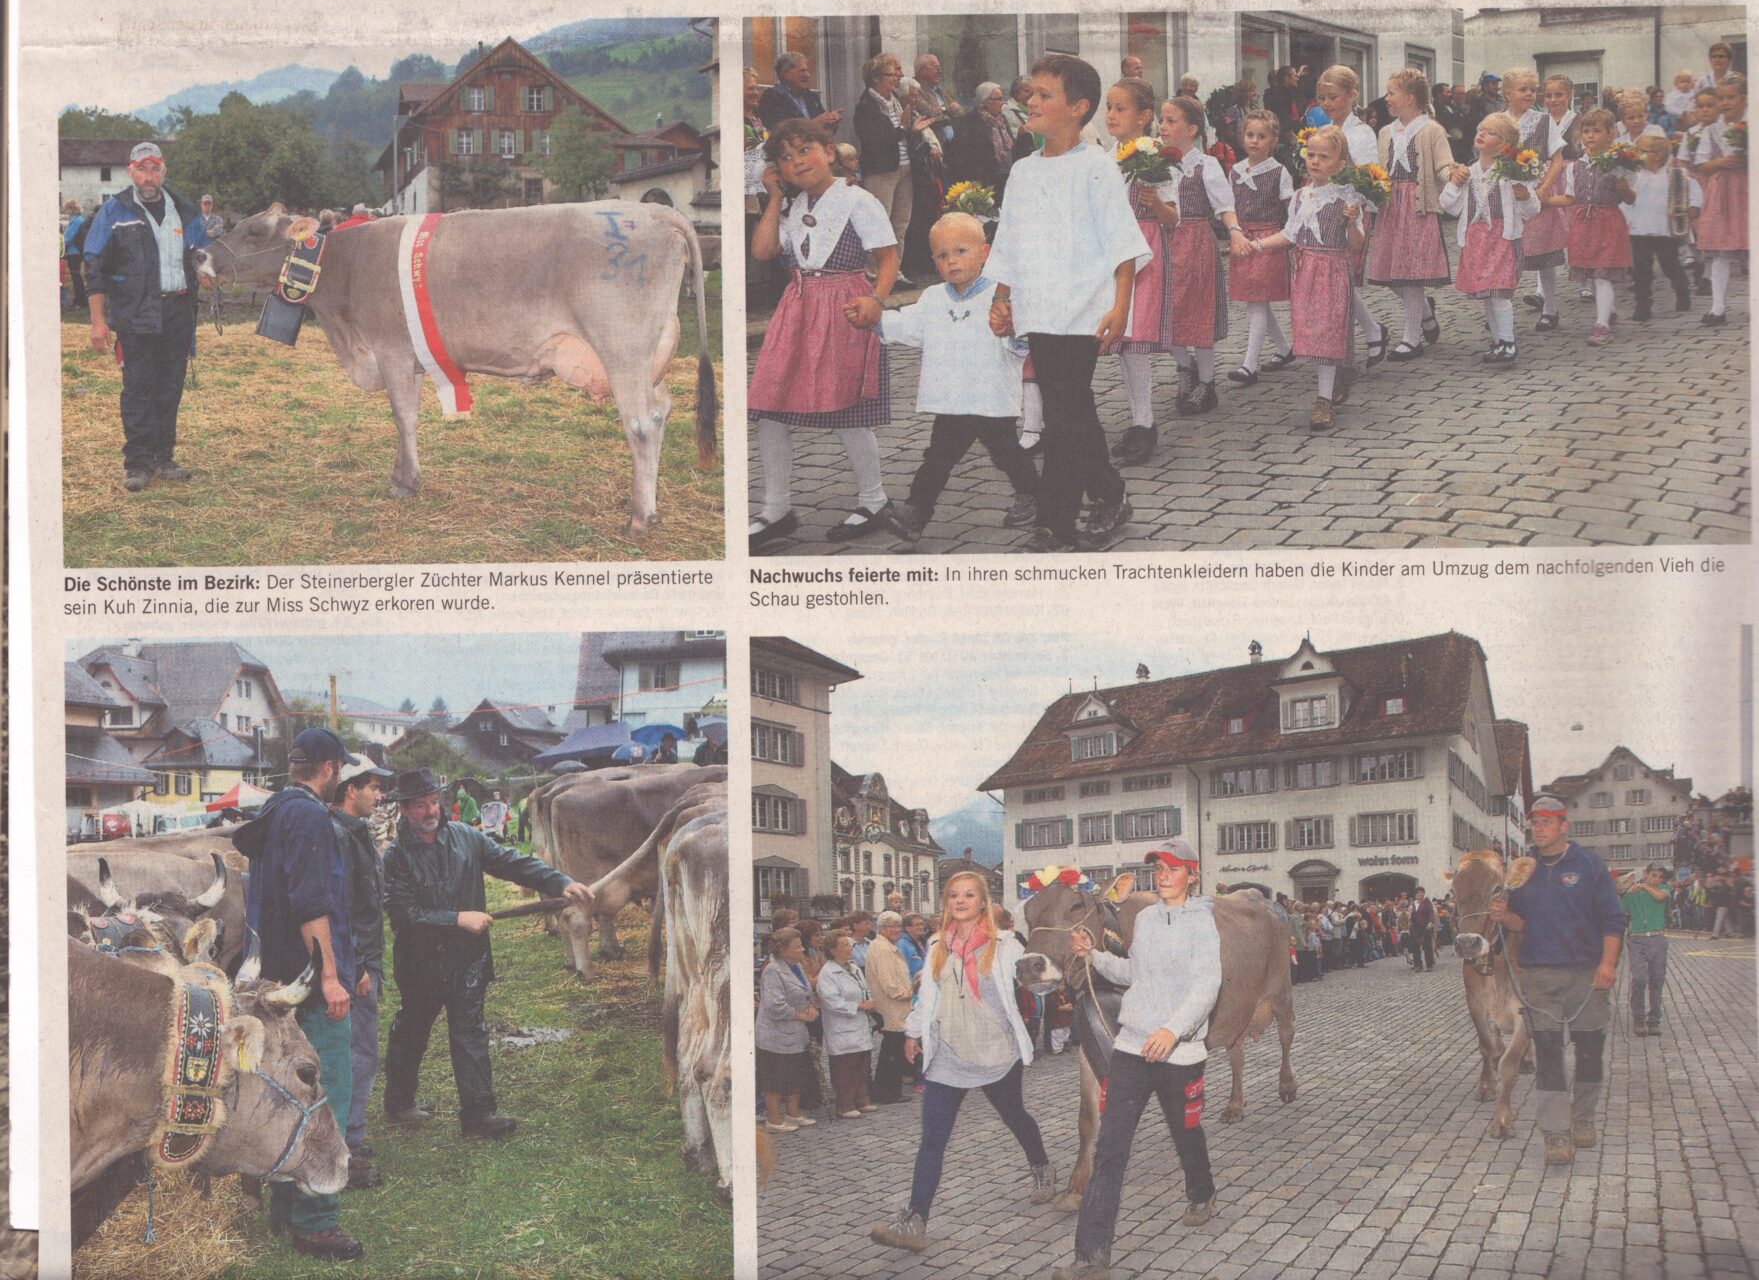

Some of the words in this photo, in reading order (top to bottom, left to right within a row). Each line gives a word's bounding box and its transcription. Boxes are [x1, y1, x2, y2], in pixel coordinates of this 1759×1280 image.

[64, 576, 91, 592] Die
[96, 575, 172, 592] Schönste
[177, 575, 198, 591] im
[204, 574, 260, 591] Bezirk:
[267, 574, 295, 590] Der
[300, 573, 415, 592] Steinerbergler
[420, 572, 483, 588] Züchter
[489, 571, 548, 587] Markus
[554, 570, 610, 586] Kennel
[617, 569, 713, 589] präsentierte
[750, 567, 843, 584] Nachwuchs
[848, 567, 901, 583] feierte
[906, 566, 939, 582] mit:
[946, 566, 961, 582] In
[968, 566, 1008, 582] ihren
[1014, 565, 1107, 581] schmucken
[1112, 563, 1248, 580] Trachtenkleidern
[1255, 562, 1304, 578] haben
[1310, 562, 1335, 578] die
[1342, 561, 1395, 577] Kinder
[1401, 564, 1425, 577] am
[1432, 560, 1489, 579] Umzug
[1494, 559, 1529, 575] dem
[1536, 558, 1654, 578] nachfolgenden
[1659, 557, 1694, 573] Vieh
[1700, 557, 1725, 573] die
[64, 603, 97, 616] sein
[104, 599, 136, 615] Kuh
[142, 598, 198, 616] Zinnia,
[204, 598, 230, 614] die
[235, 601, 261, 613] zur
[267, 597, 304, 613] Miss
[309, 596, 369, 615] Schwyz
[375, 595, 435, 611] erkoren
[441, 594, 495, 611] wurde.
[750, 591, 800, 607] Schau
[805, 590, 889, 610] gestohlen.
